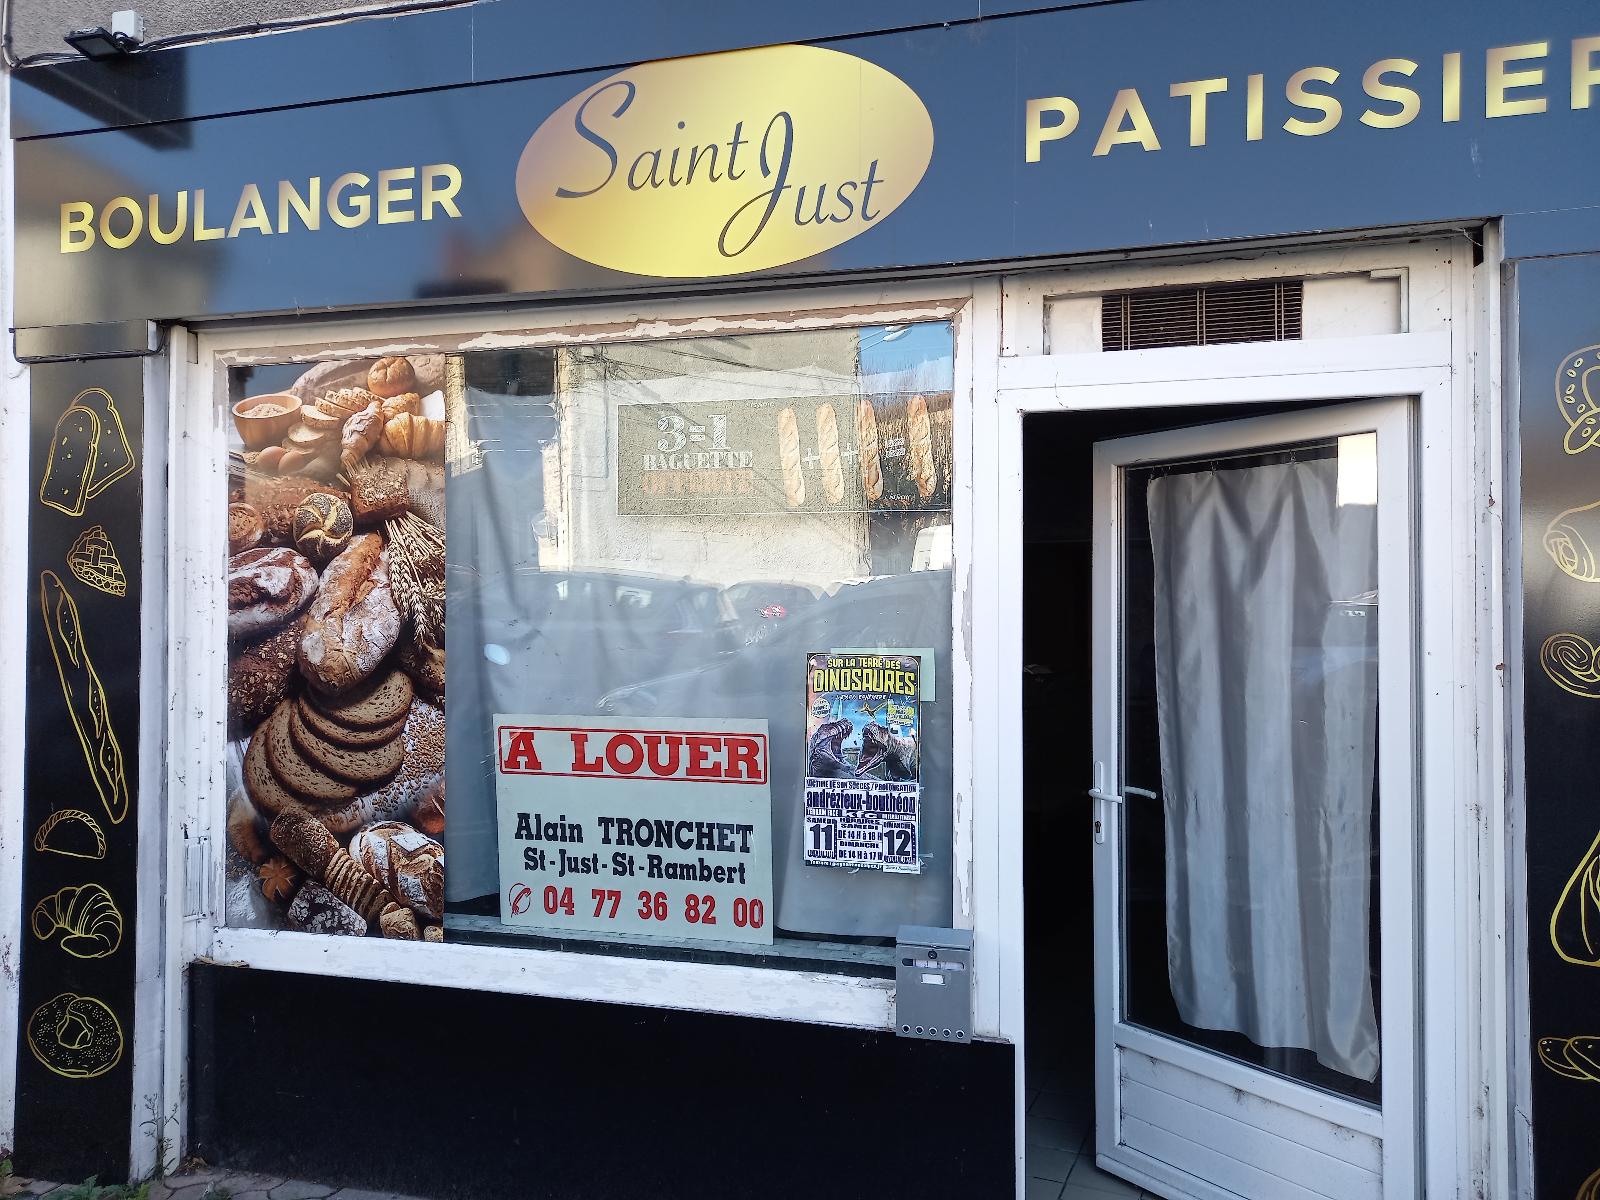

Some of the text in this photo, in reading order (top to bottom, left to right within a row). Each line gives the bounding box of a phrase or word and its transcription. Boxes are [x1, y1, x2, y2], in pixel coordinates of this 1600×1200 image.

[555, 80, 748, 199] Saint
[718, 111, 885, 257] Just
[60, 163, 463, 254] BOULANGER
[642, 450, 754, 471] BAGUETTE
[827, 657, 901, 669] SUR LA TERRE DES
[812, 668, 917, 696] DINOSAURES
[504, 731, 762, 780] A LOUER
[806, 788, 916, 813] andrézieux-bouthéon
[514, 812, 754, 854] Alain TRONCHET
[809, 823, 833, 851] 11
[838, 830, 847, 839] DE
[848, 830, 855, 839] 14
[856, 831, 862, 840] H
[868, 831, 876, 841] 18
[877, 832, 883, 842] H
[883, 829, 911, 857] 12
[838, 850, 847, 858] DE
[857, 851, 862, 860] H
[868, 851, 876, 861] 17
[877, 852, 883, 861] H
[543, 885, 764, 929] 04 77 36 82 00
